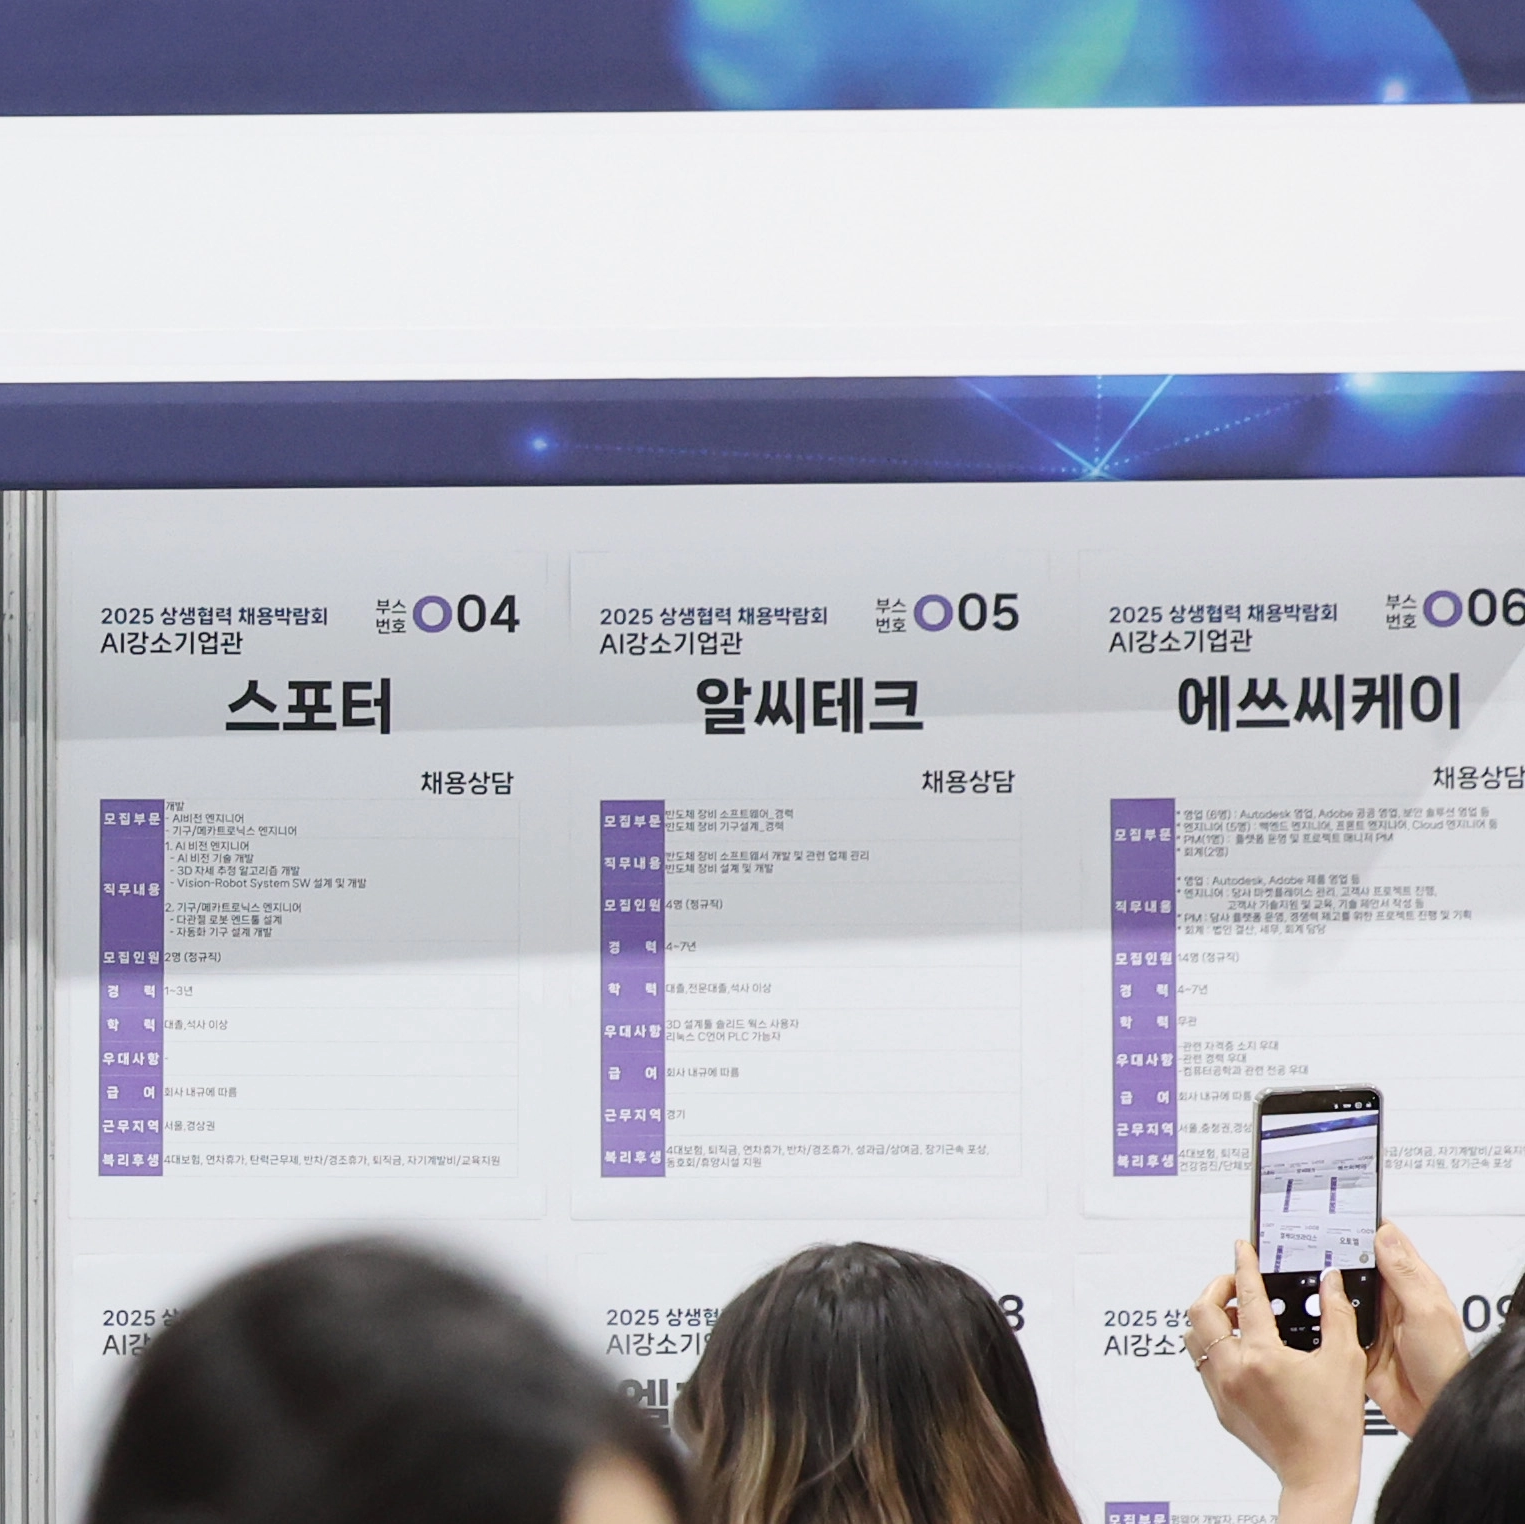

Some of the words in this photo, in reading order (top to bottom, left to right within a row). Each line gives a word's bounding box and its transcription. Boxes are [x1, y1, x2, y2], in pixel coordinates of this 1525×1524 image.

[375, 599, 407, 615] 부스
[412, 593, 521, 634] O04
[875, 597, 907, 614] 부스
[913, 592, 1020, 633] O05
[1109, 606, 1163, 624] 2025
[1168, 604, 1241, 624] 상생협력
[1247, 603, 1338, 623] 채용박람회
[1385, 594, 1417, 611] 부스
[1422, 587, 1525, 628] O06
[101, 607, 155, 625] 2025
[160, 606, 232, 626] 상생협력
[238, 606, 328, 626] 채용박람회
[375, 618, 407, 635] 번호
[600, 608, 654, 626] 2025
[659, 606, 732, 627] 상생협력
[737, 606, 828, 626] 채용박람회
[875, 617, 907, 634] 번호
[1385, 613, 1417, 630] 번호
[100, 631, 244, 656] AI강소기업관
[599, 631, 743, 656] AI강소기업관
[1108, 628, 1253, 654] AI강소기업관
[225, 677, 391, 735] 스포터
[696, 676, 924, 735] 알씨테크
[1178, 672, 1460, 733] 에쓰씨케이
[421, 771, 514, 796] 채용상담
[921, 769, 1016, 794] 채용상담
[1433, 765, 1525, 790] 채용상담
[102, 1309, 156, 1327] 2025
[606, 1309, 660, 1326] 2025
[666, 1308, 719, 1327] 상생협
[1103, 1309, 1158, 1327] 2025
[605, 1332, 712, 1357] AI강소기
